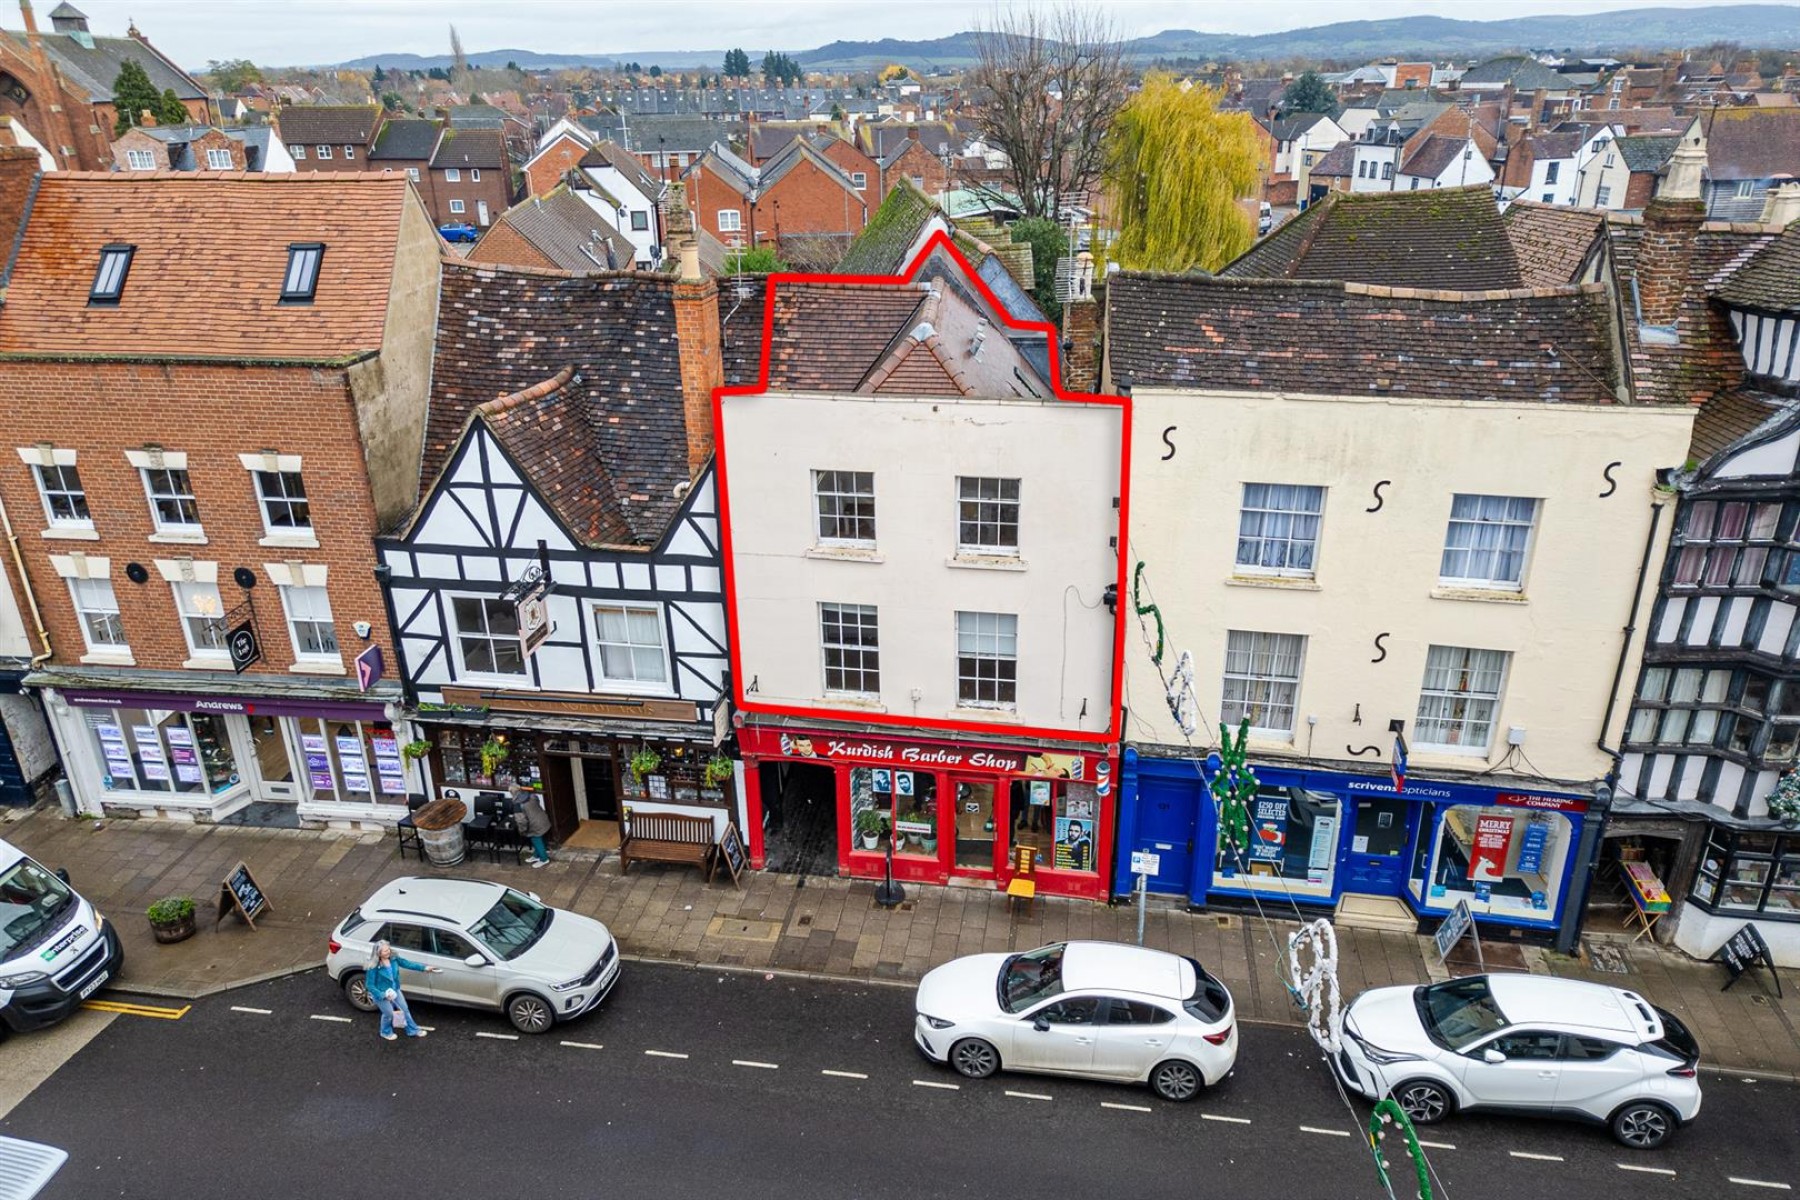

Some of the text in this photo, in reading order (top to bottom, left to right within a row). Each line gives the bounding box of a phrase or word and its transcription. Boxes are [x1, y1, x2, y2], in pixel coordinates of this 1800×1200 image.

[237, 638, 247, 647] The
[238, 644, 250, 656] Loft
[195, 700, 244, 711] Andrews
[827, 740, 1018, 772] Kurdish Barber Shop
[1347, 781, 1451, 798] scrivens opticians
[1526, 801, 1560, 809] COMPANY
[1542, 797, 1574, 805] HEARING
[1274, 802, 1288, 811] OFF
[1257, 808, 1287, 817] SELECTED
[1479, 819, 1512, 830] MERRY
